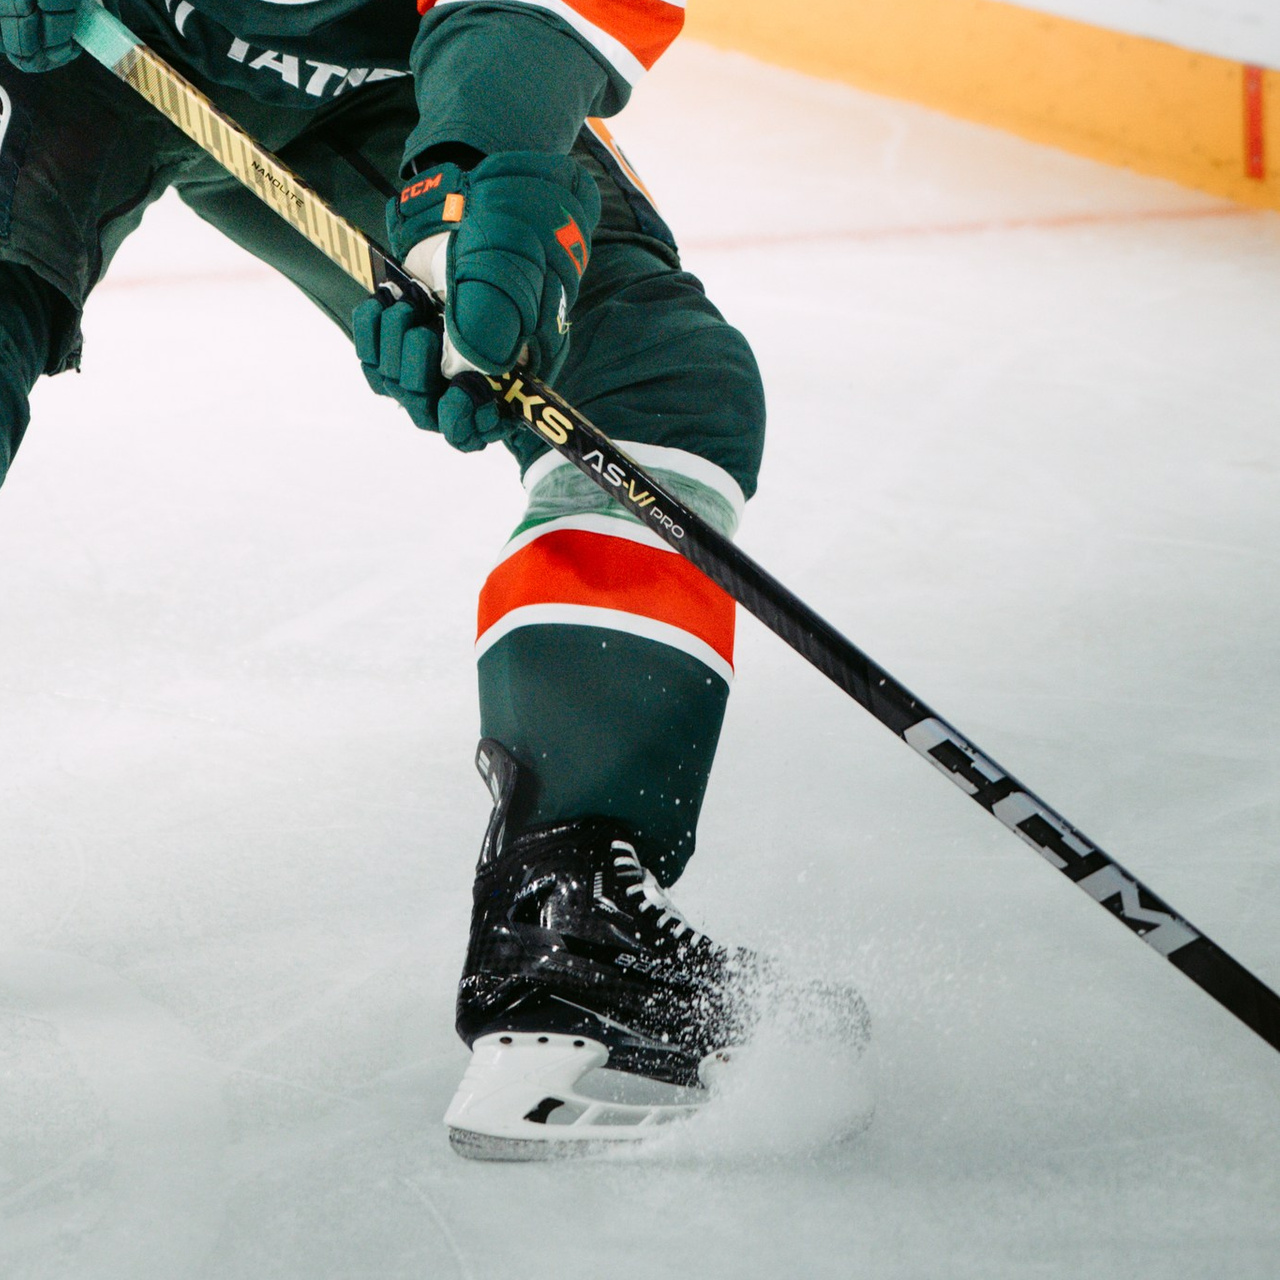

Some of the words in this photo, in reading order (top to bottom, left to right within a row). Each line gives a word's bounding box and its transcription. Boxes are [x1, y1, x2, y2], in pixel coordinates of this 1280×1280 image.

[251, 160, 305, 209] NANOLITE
[400, 172, 444, 205] CCM
[649, 506, 686, 539] PRO
[903, 717, 1202, 957] CCM
